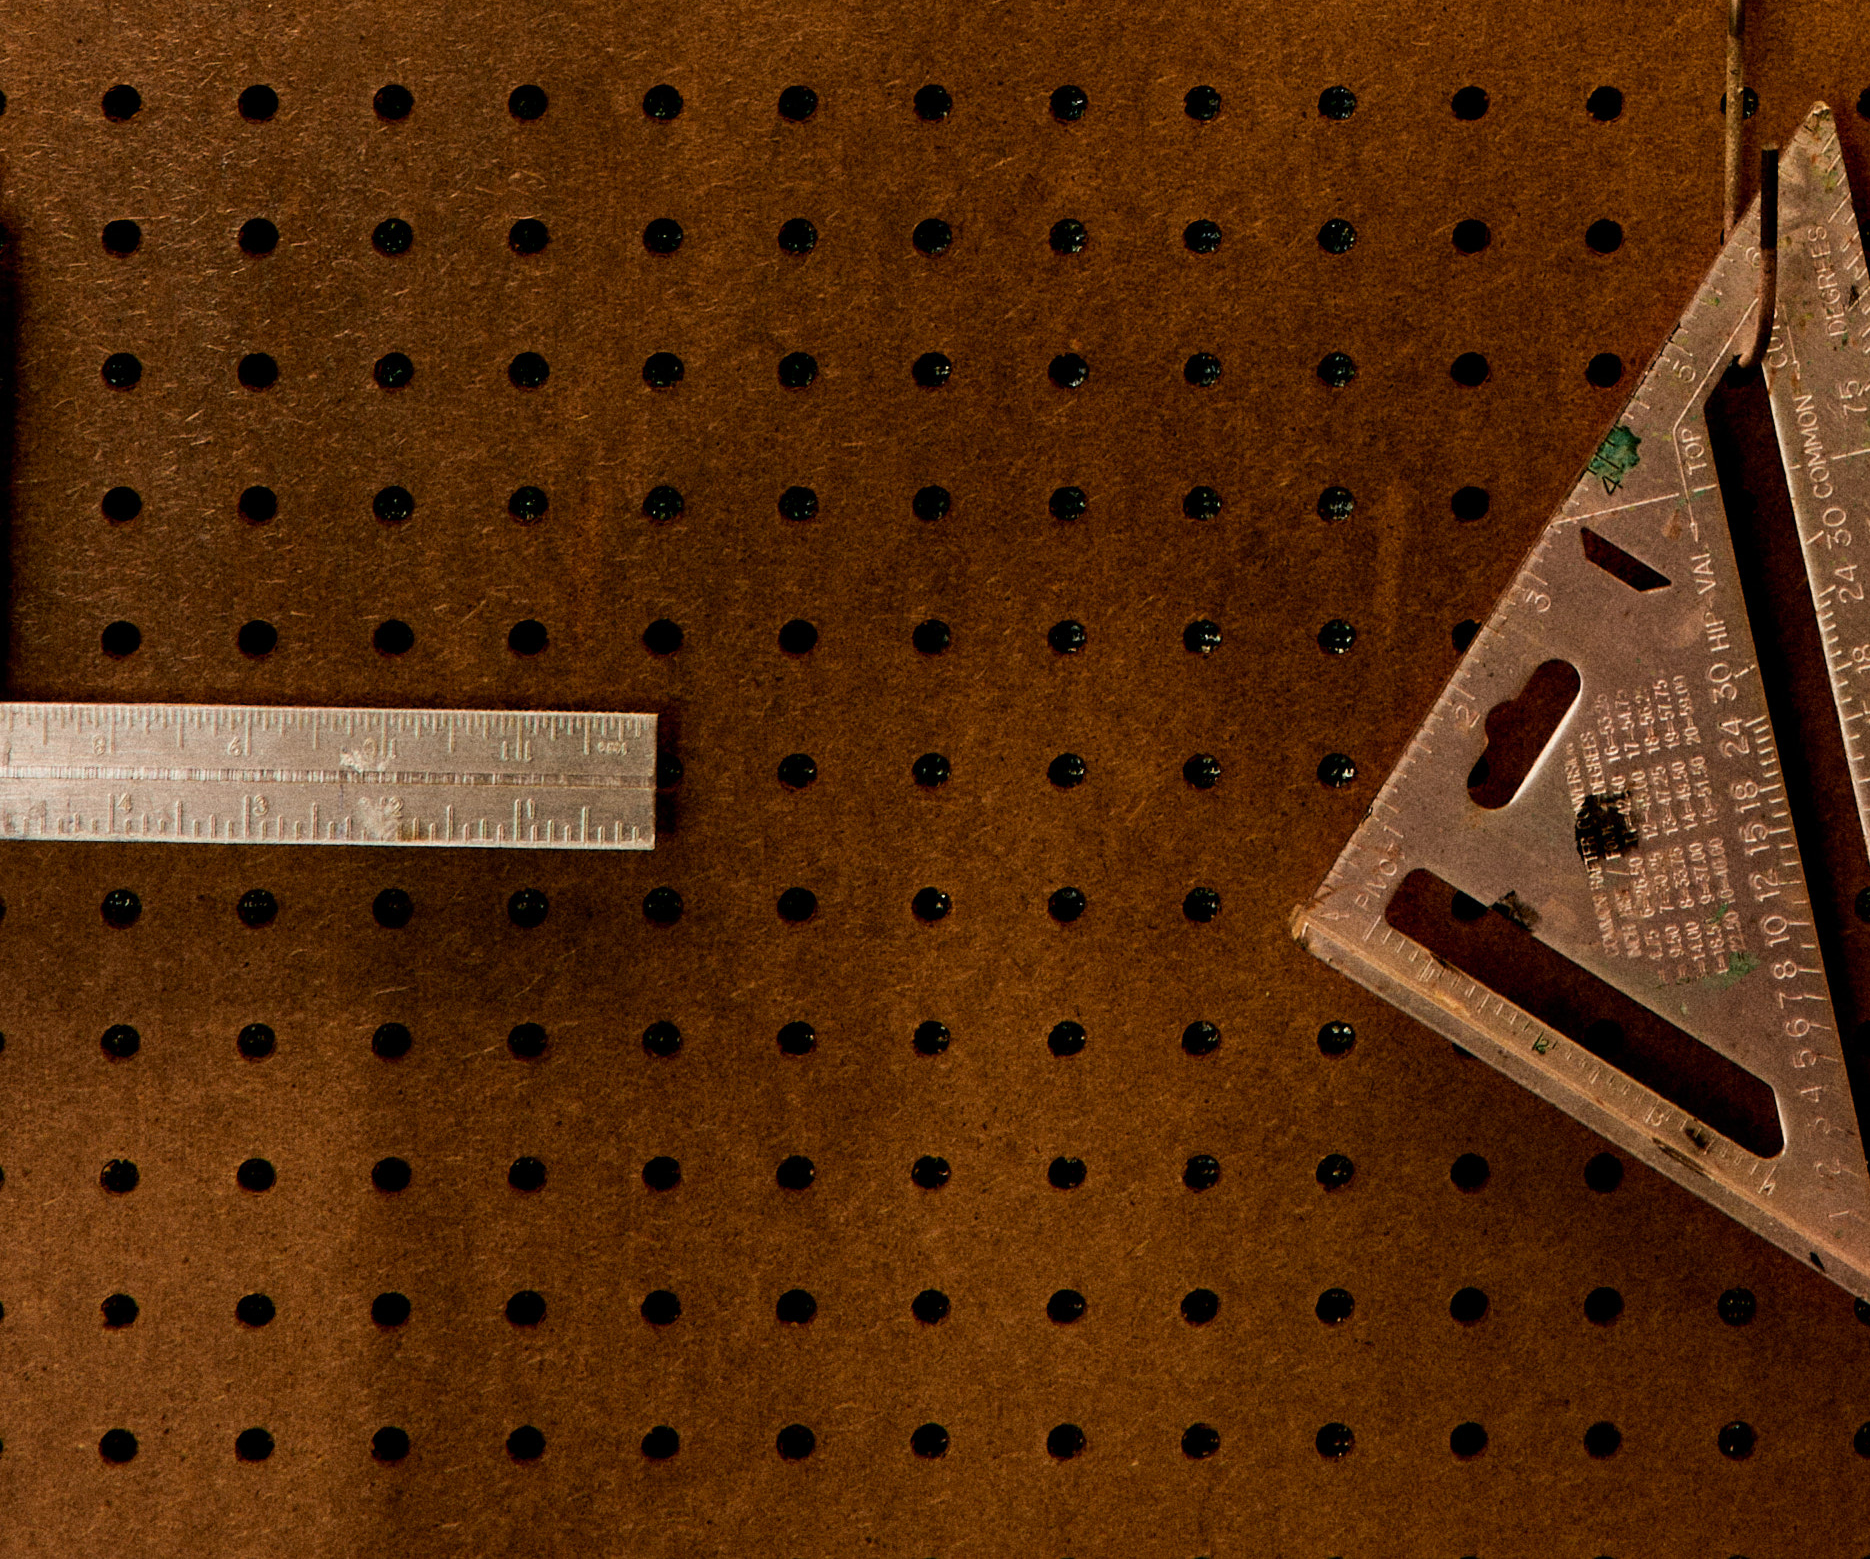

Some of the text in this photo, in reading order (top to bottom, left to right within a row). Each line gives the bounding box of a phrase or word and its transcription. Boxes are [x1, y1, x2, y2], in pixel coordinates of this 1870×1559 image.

[1807, 226, 1849, 337] DEGREES
[1840, 380, 1868, 416] 75
[1681, 428, 1708, 476] TOP
[1793, 393, 1833, 499] COMMON
[1455, 703, 1480, 730] 2
[1525, 585, 1552, 614] 3
[1602, 476, 1623, 496] 4
[1673, 359, 1697, 383] 5
[1822, 507, 1852, 550] 30
[1835, 564, 1864, 603] 24
[1708, 663, 1737, 703] 30
[1652, 679, 1681, 751] 19=57.75
[1672, 674, 1701, 746] 20=59.00
[1721, 719, 1750, 757] 24
[1580, 730, 1608, 795] DEGREES
[117, 793, 133, 814] 4
[251, 794, 269, 817] 3
[1650, 765, 1679, 837] 13=47.25
[1671, 760, 1698, 831] 14=49.50
[1690, 755, 1720, 824] 15=51.50
[1731, 781, 1761, 813] 18
[1739, 823, 1770, 856] 15
[1579, 836, 1605, 891] RAFTER
[1669, 847, 1695, 910] 8=33.75
[1688, 841, 1715, 905] 9=37.00
[1752, 869, 1781, 901] 12
[1764, 915, 1791, 946] 10
[1773, 960, 1797, 980] 8
[1786, 1018, 1810, 1038] 6
[1792, 1050, 1816, 1068] 5
